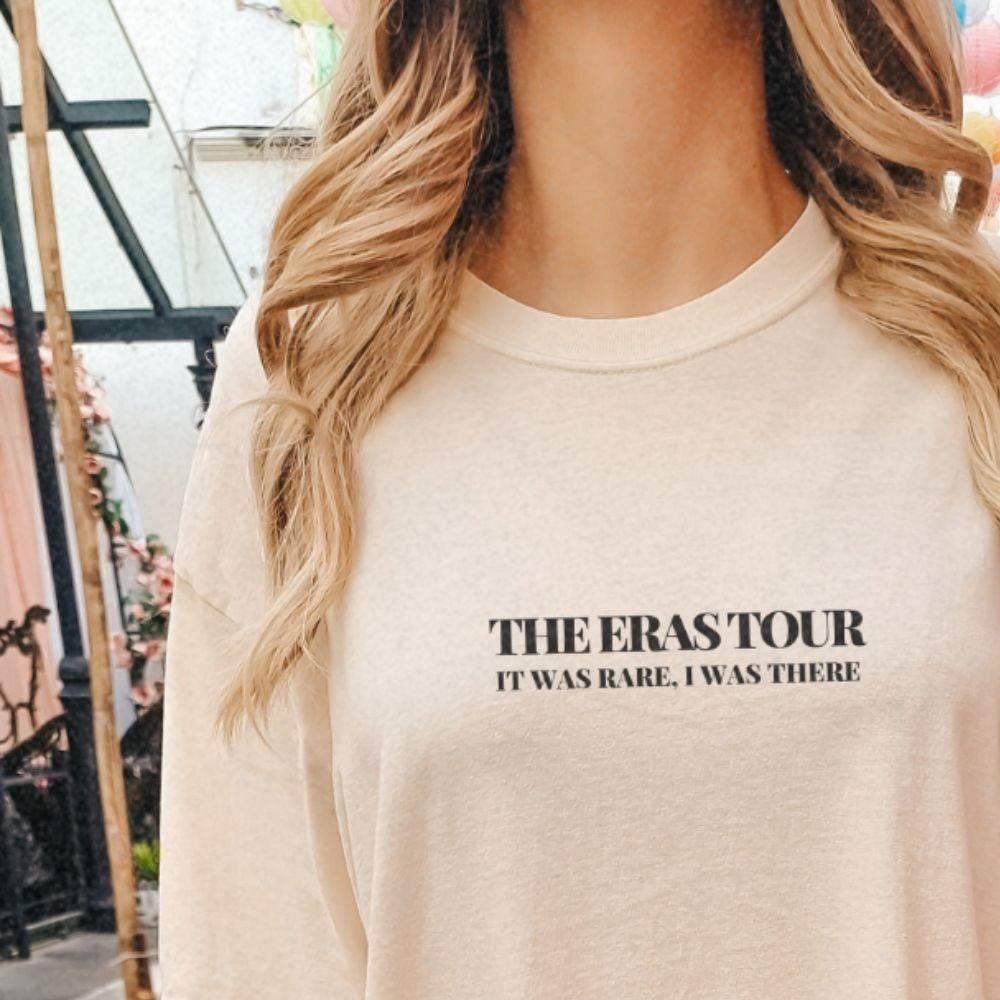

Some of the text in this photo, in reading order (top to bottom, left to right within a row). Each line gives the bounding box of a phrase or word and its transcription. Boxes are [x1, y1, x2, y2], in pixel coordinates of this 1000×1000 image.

[488, 609, 867, 656] THE ERAS TOUR
[496, 661, 861, 692] IT WAS RARE, I WAS THERE
